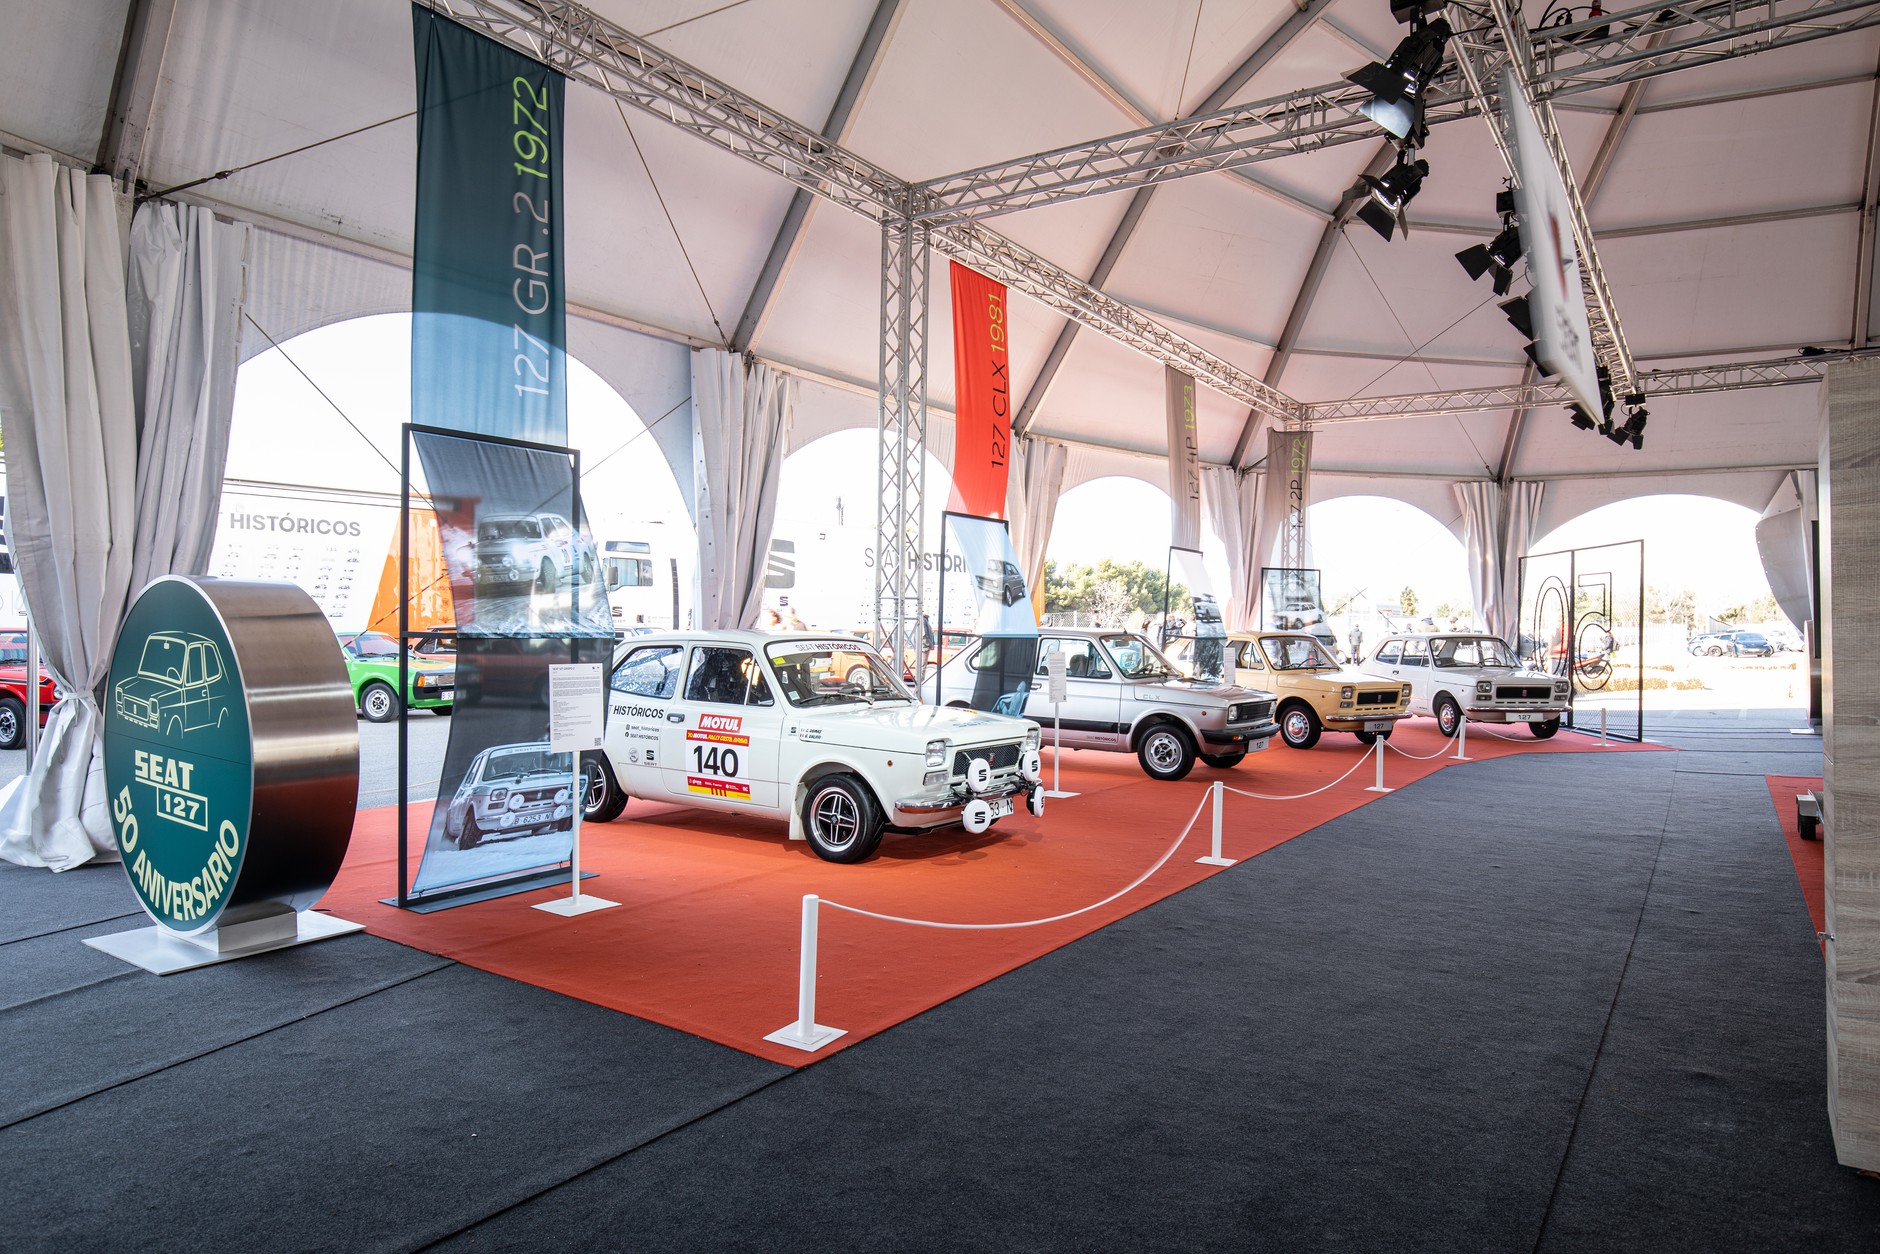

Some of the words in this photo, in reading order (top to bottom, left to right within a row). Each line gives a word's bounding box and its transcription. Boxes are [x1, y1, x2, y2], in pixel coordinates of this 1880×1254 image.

[513, 76, 549, 179] 1972
[988, 293, 1005, 353] 1981
[514, 324, 549, 397] 127
[992, 360, 1006, 417] CLX
[1184, 385, 1195, 430] 1973
[991, 424, 1006, 467] 127
[1291, 438, 1307, 475] 1972
[1290, 479, 1303, 501] 2P
[230, 512, 361, 537] HISTÓRICOS
[795, 644, 814, 652] SEAT
[814, 642, 861, 651] HISTÓRICOS
[613, 704, 665, 719] HISTÓRICOS
[700, 716, 739, 731] MOTUL
[693, 732, 708, 740] MOTUL
[1256, 741, 1264, 749] 127
[134, 749, 194, 791] SEAT
[693, 745, 739, 777] 140
[163, 793, 200, 820] 127
[114, 785, 139, 854] 50
[132, 819, 240, 921] ANIVERSARIO
